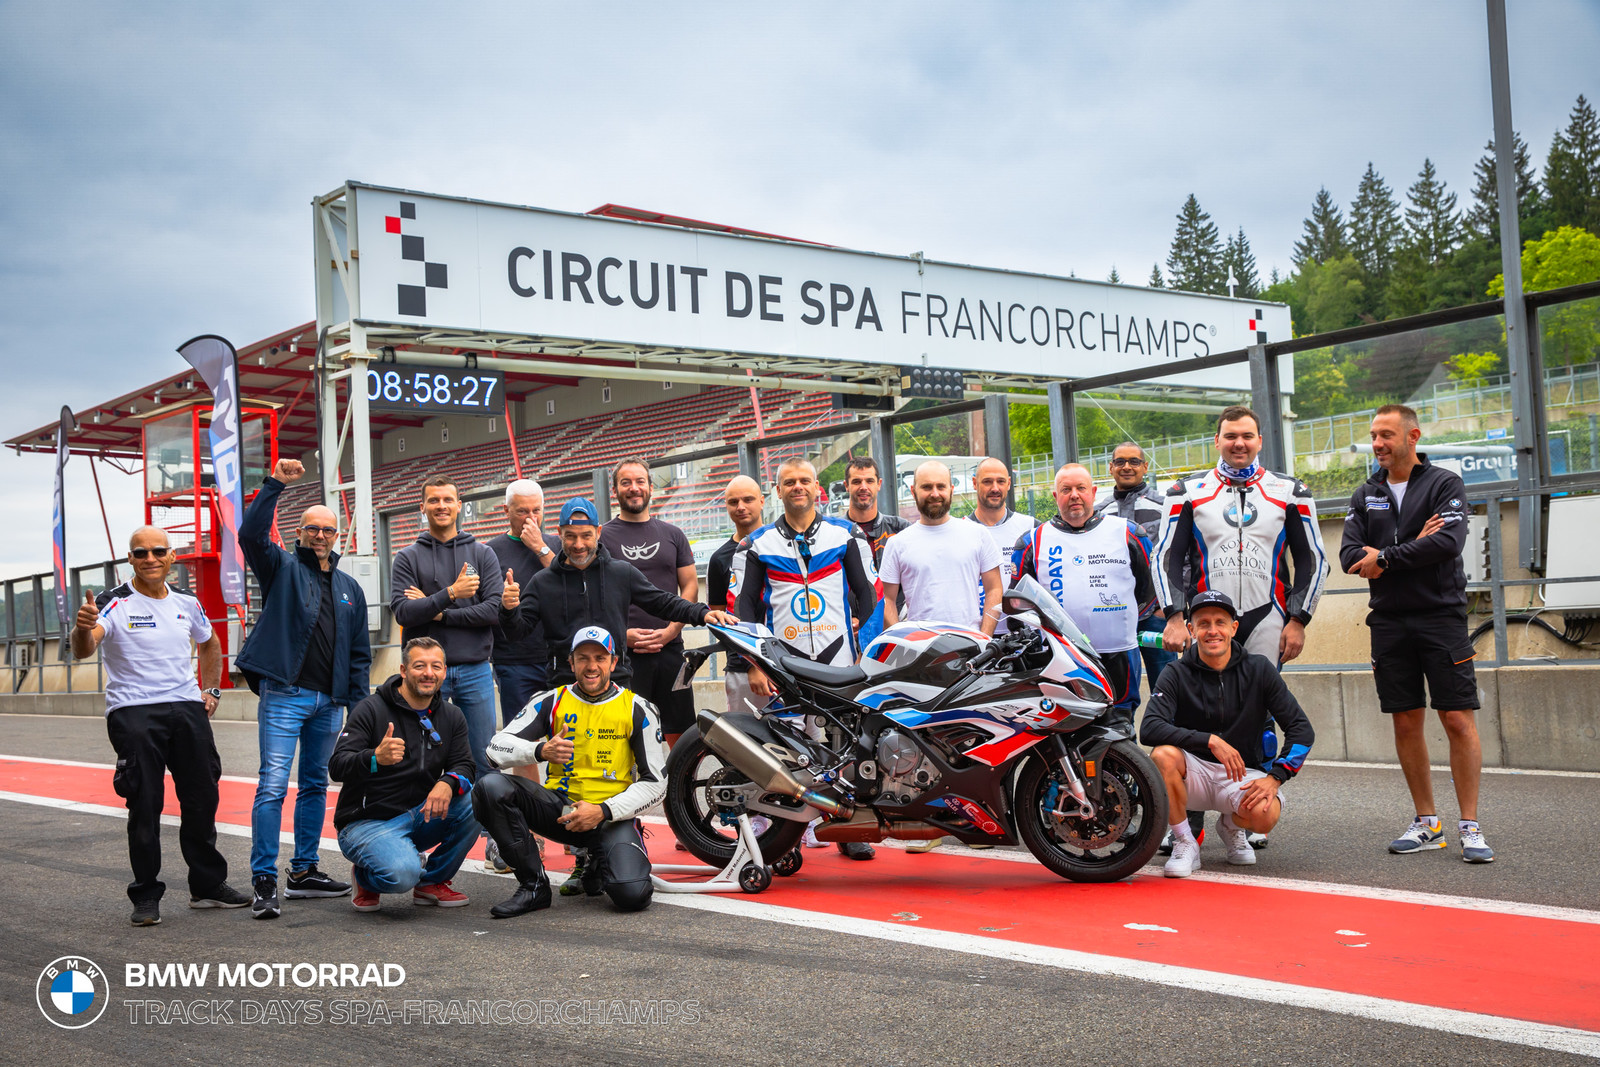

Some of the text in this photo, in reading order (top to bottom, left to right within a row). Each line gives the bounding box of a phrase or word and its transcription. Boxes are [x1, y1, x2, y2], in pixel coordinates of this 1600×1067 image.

[507, 246, 708, 314] CIRCUIT
[725, 270, 784, 322] DE
[800, 280, 883, 332] SPA
[367, 369, 498, 407] 08:58:27
[1220, 539, 1259, 554] BOXER
[1213, 557, 1266, 570] EVASION
[797, 624, 837, 632] Location
[634, 802, 651, 815] BMW
